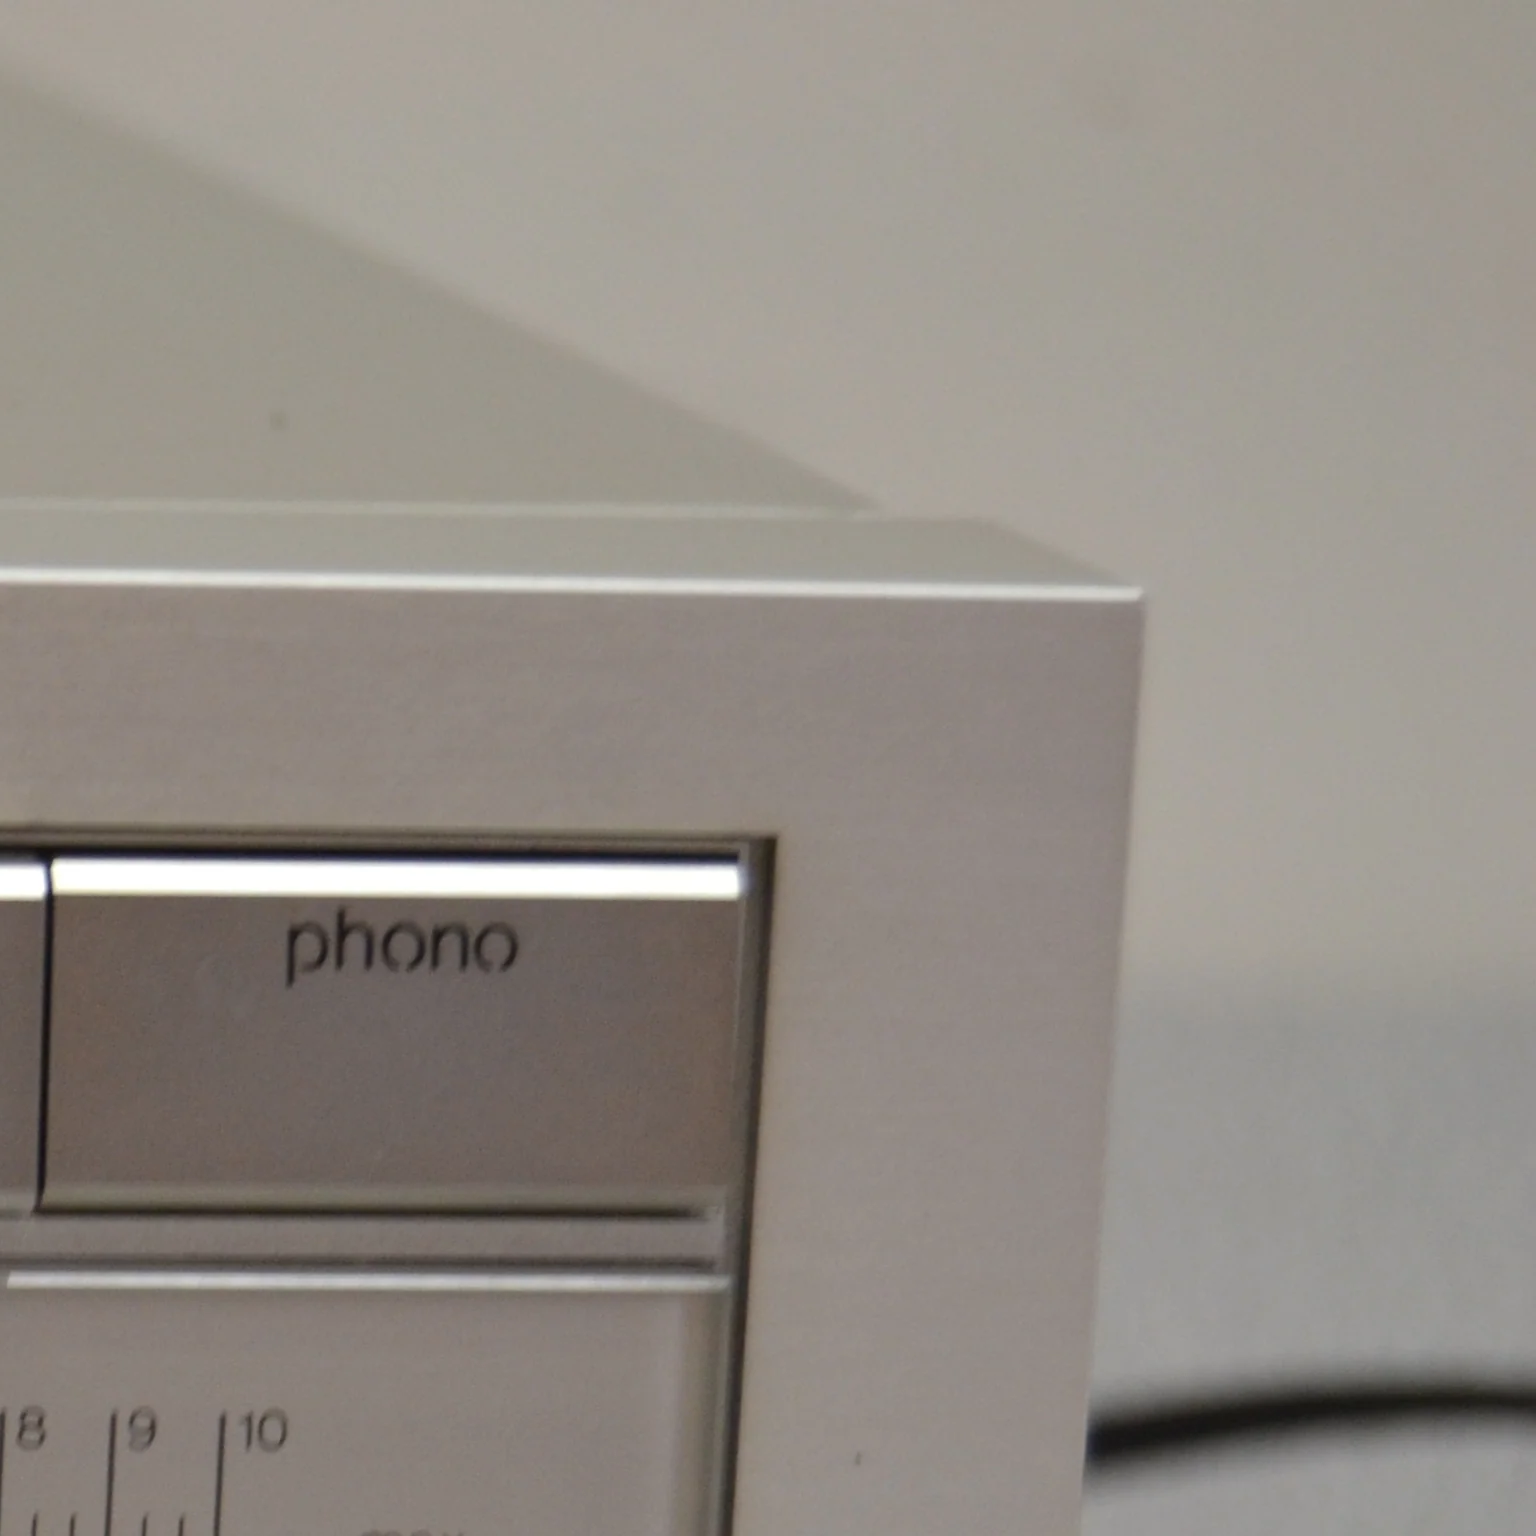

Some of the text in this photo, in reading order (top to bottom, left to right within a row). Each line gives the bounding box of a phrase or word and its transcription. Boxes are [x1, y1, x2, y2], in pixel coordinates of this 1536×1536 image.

[282, 903, 523, 990] phono
[16, 1408, 49, 1450] 8
[128, 1409, 160, 1451] 9
[242, 1409, 291, 1454] 10
